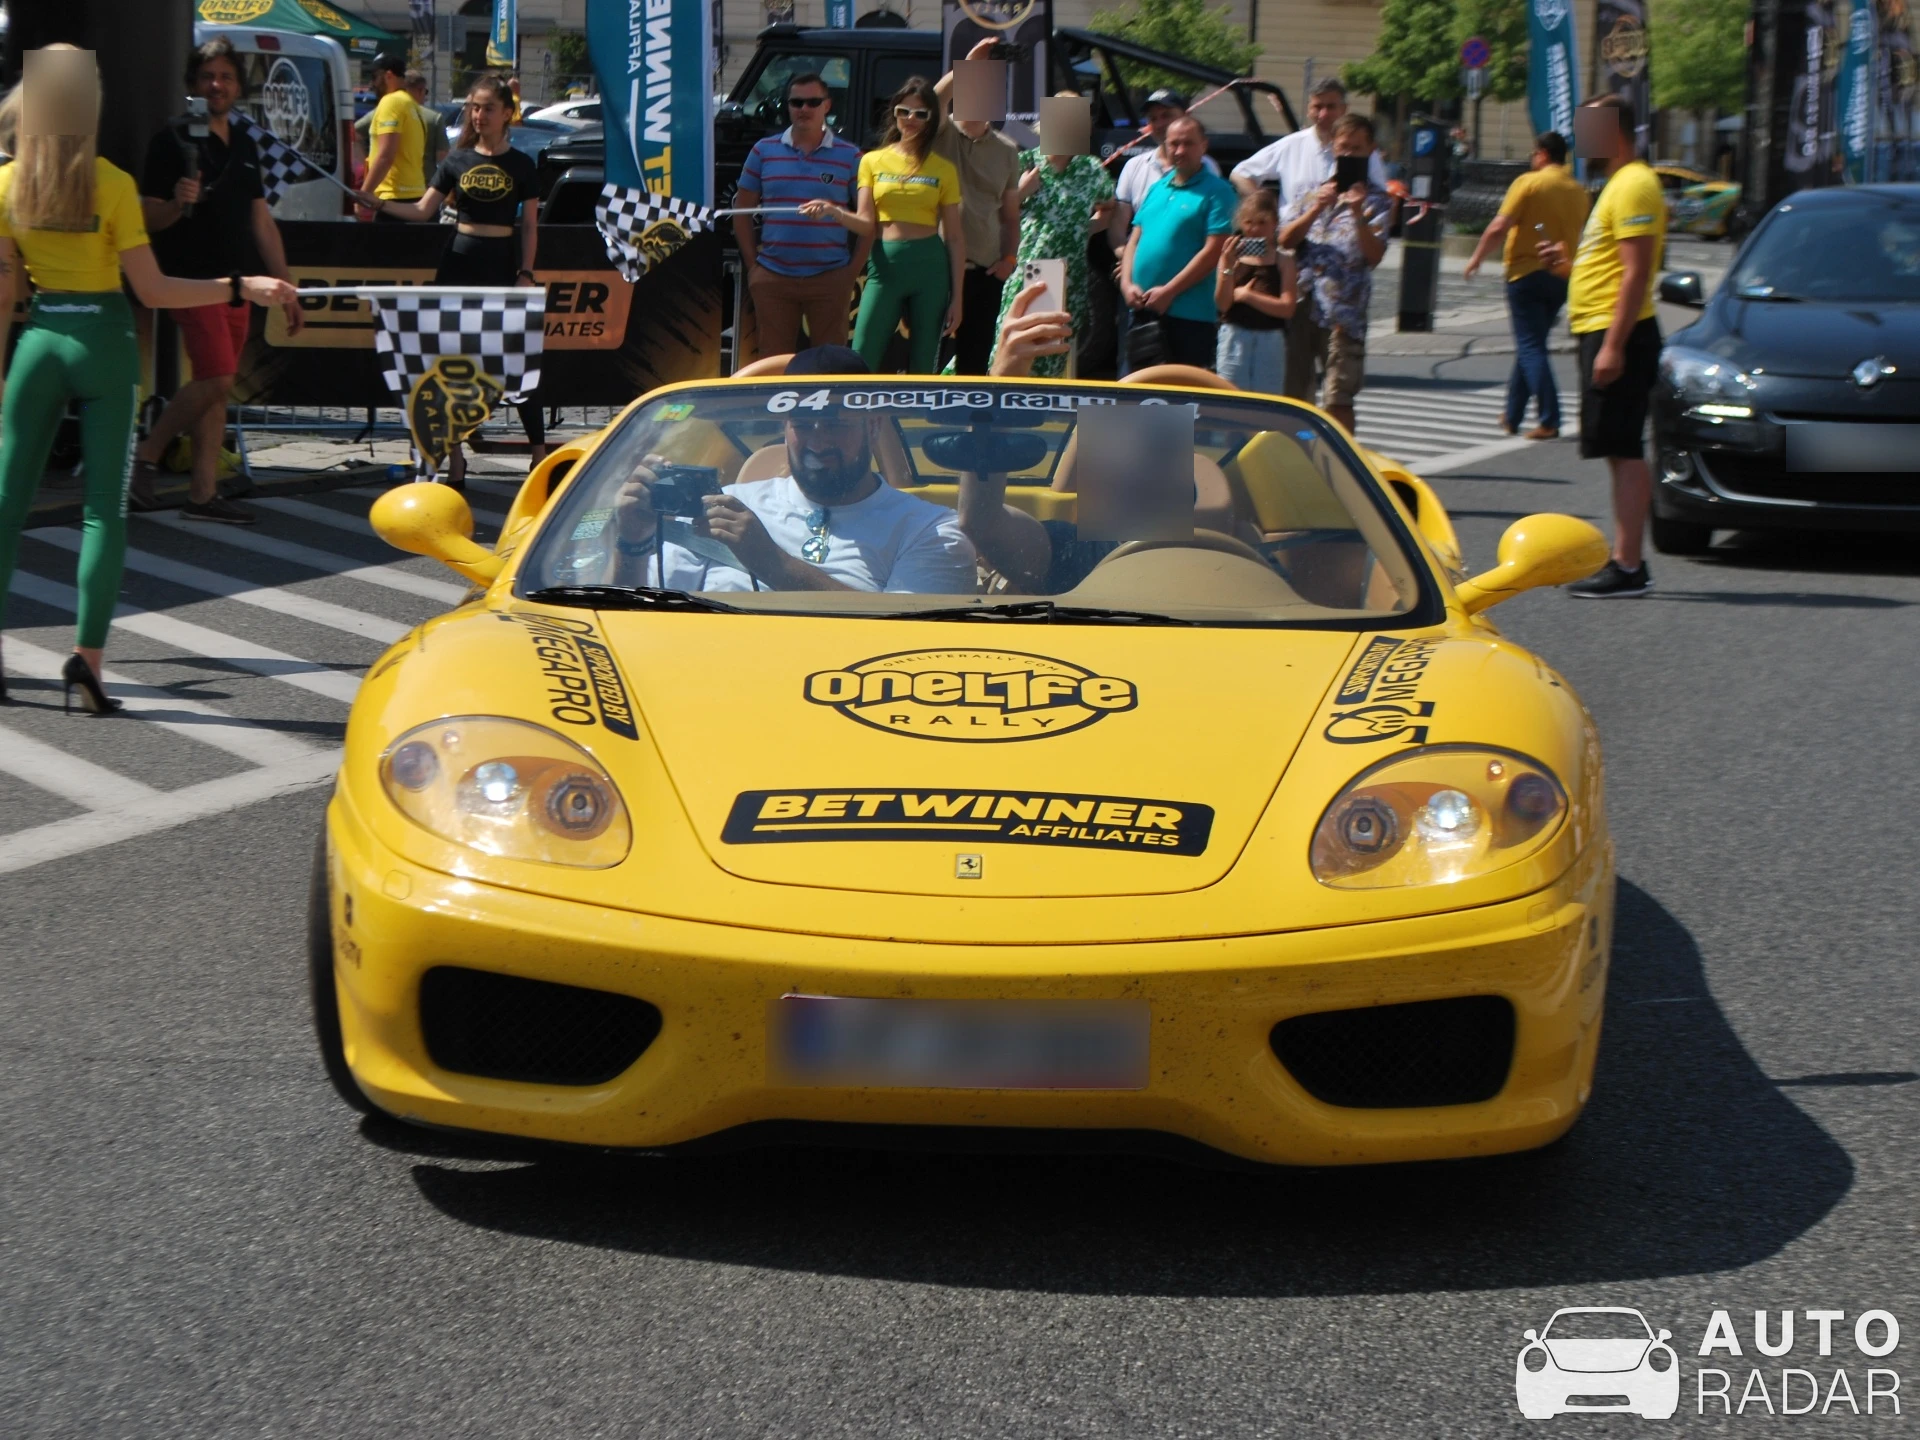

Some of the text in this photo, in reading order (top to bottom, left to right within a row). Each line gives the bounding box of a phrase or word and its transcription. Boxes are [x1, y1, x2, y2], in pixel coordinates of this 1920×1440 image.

[766, 389, 830, 413] 64
[889, 714, 1055, 728] RALLY
[1008, 824, 1180, 848] AFFILIATES
